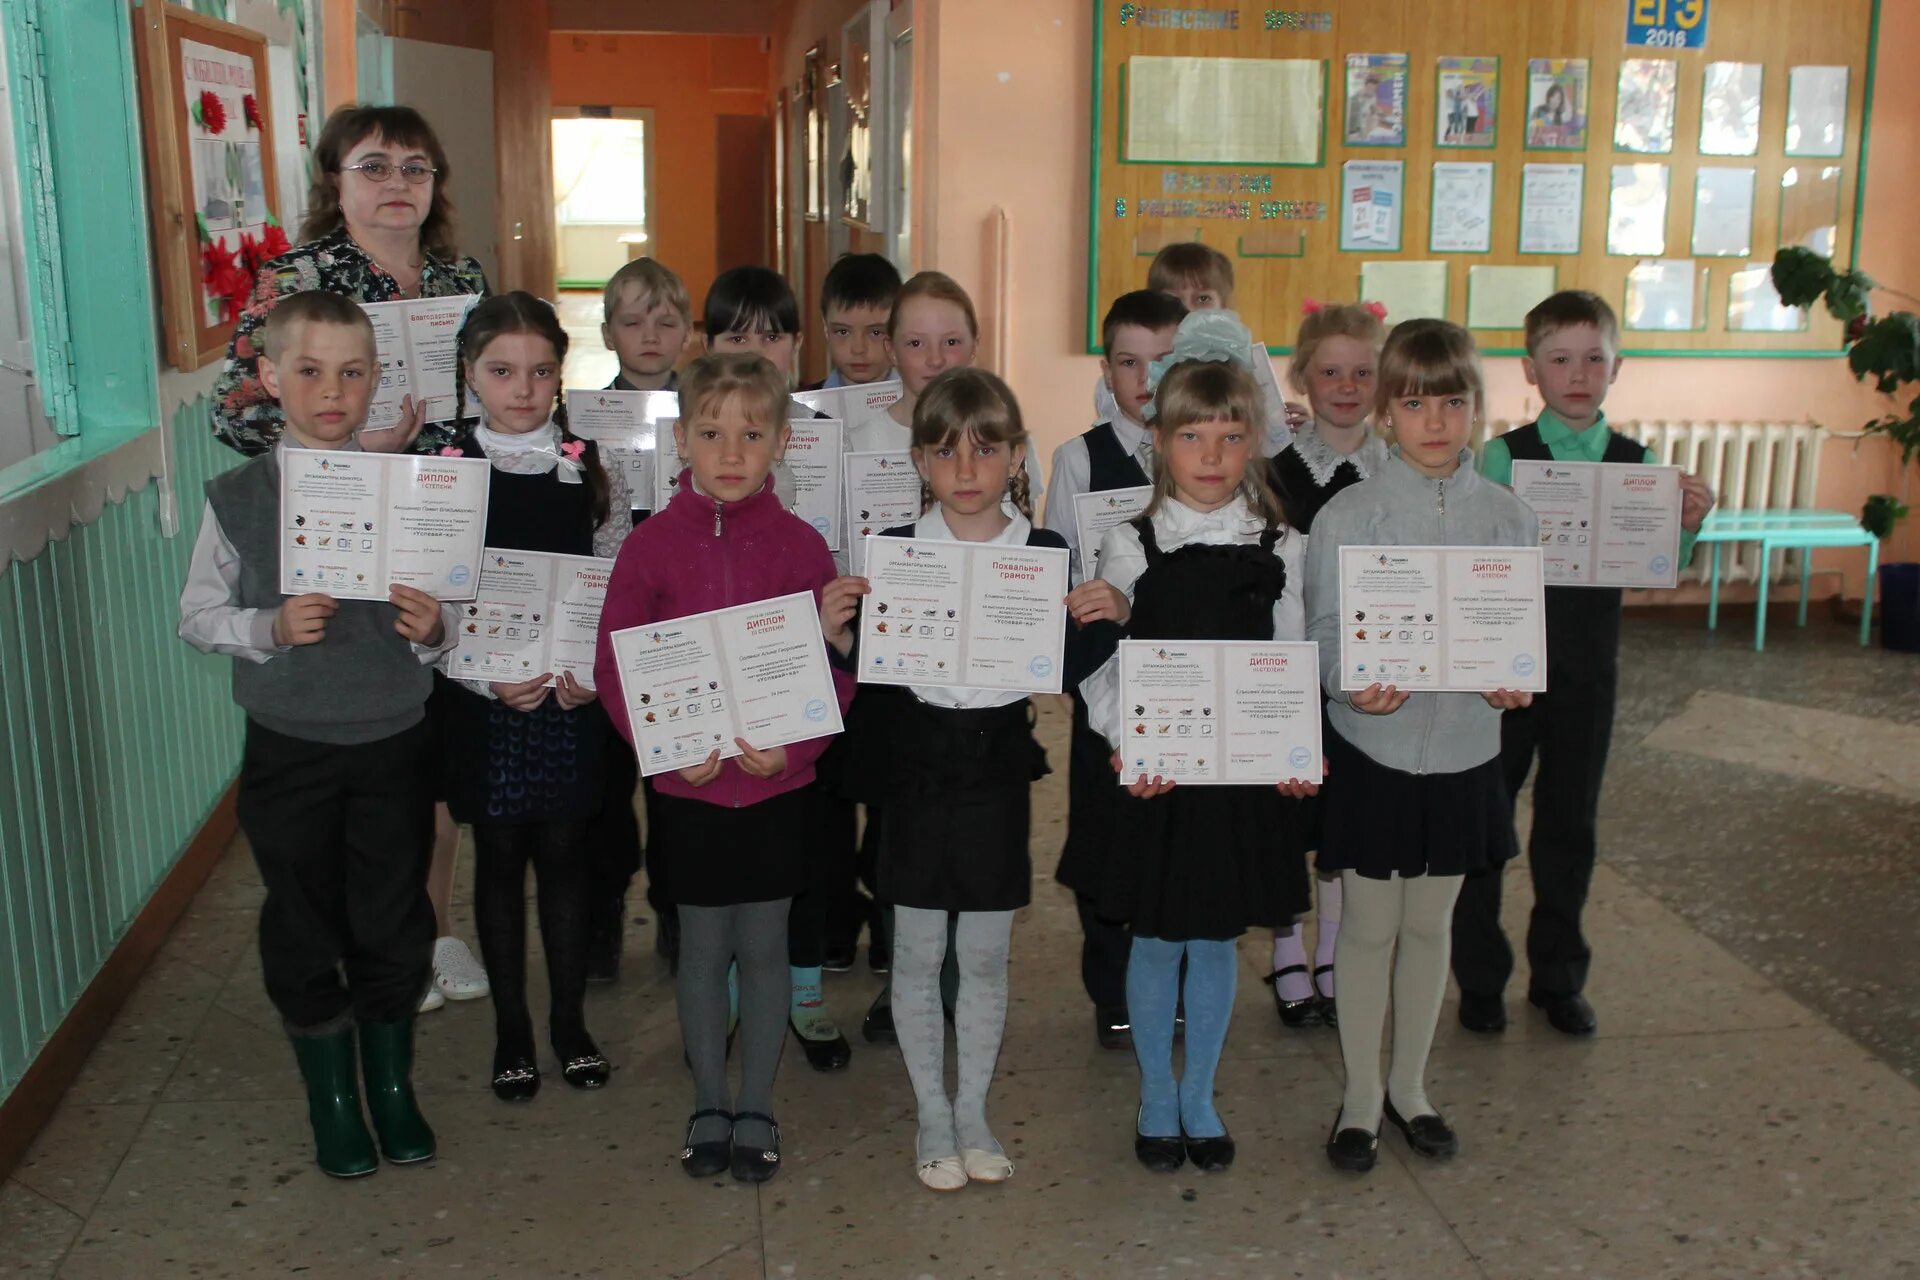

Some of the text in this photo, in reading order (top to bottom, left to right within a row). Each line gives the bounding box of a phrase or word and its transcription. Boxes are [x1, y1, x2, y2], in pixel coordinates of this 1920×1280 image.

[1646, 28, 1686, 47] 2016
[411, 313, 460, 321] Благодарствен
[866, 394, 897, 404] ДИПЛОМ
[417, 474, 457, 483] ДИПЛОМ
[992, 561, 1044, 572] Похвальная
[1472, 564, 1512, 572] ДИПЛОМ
[576, 572, 610, 581] Похваль
[1000, 572, 1035, 580] грамота
[583, 581, 608, 589] грамо
[747, 614, 785, 630] ДИПЛОМ
[758, 625, 784, 634] СТЕПЕНИ
